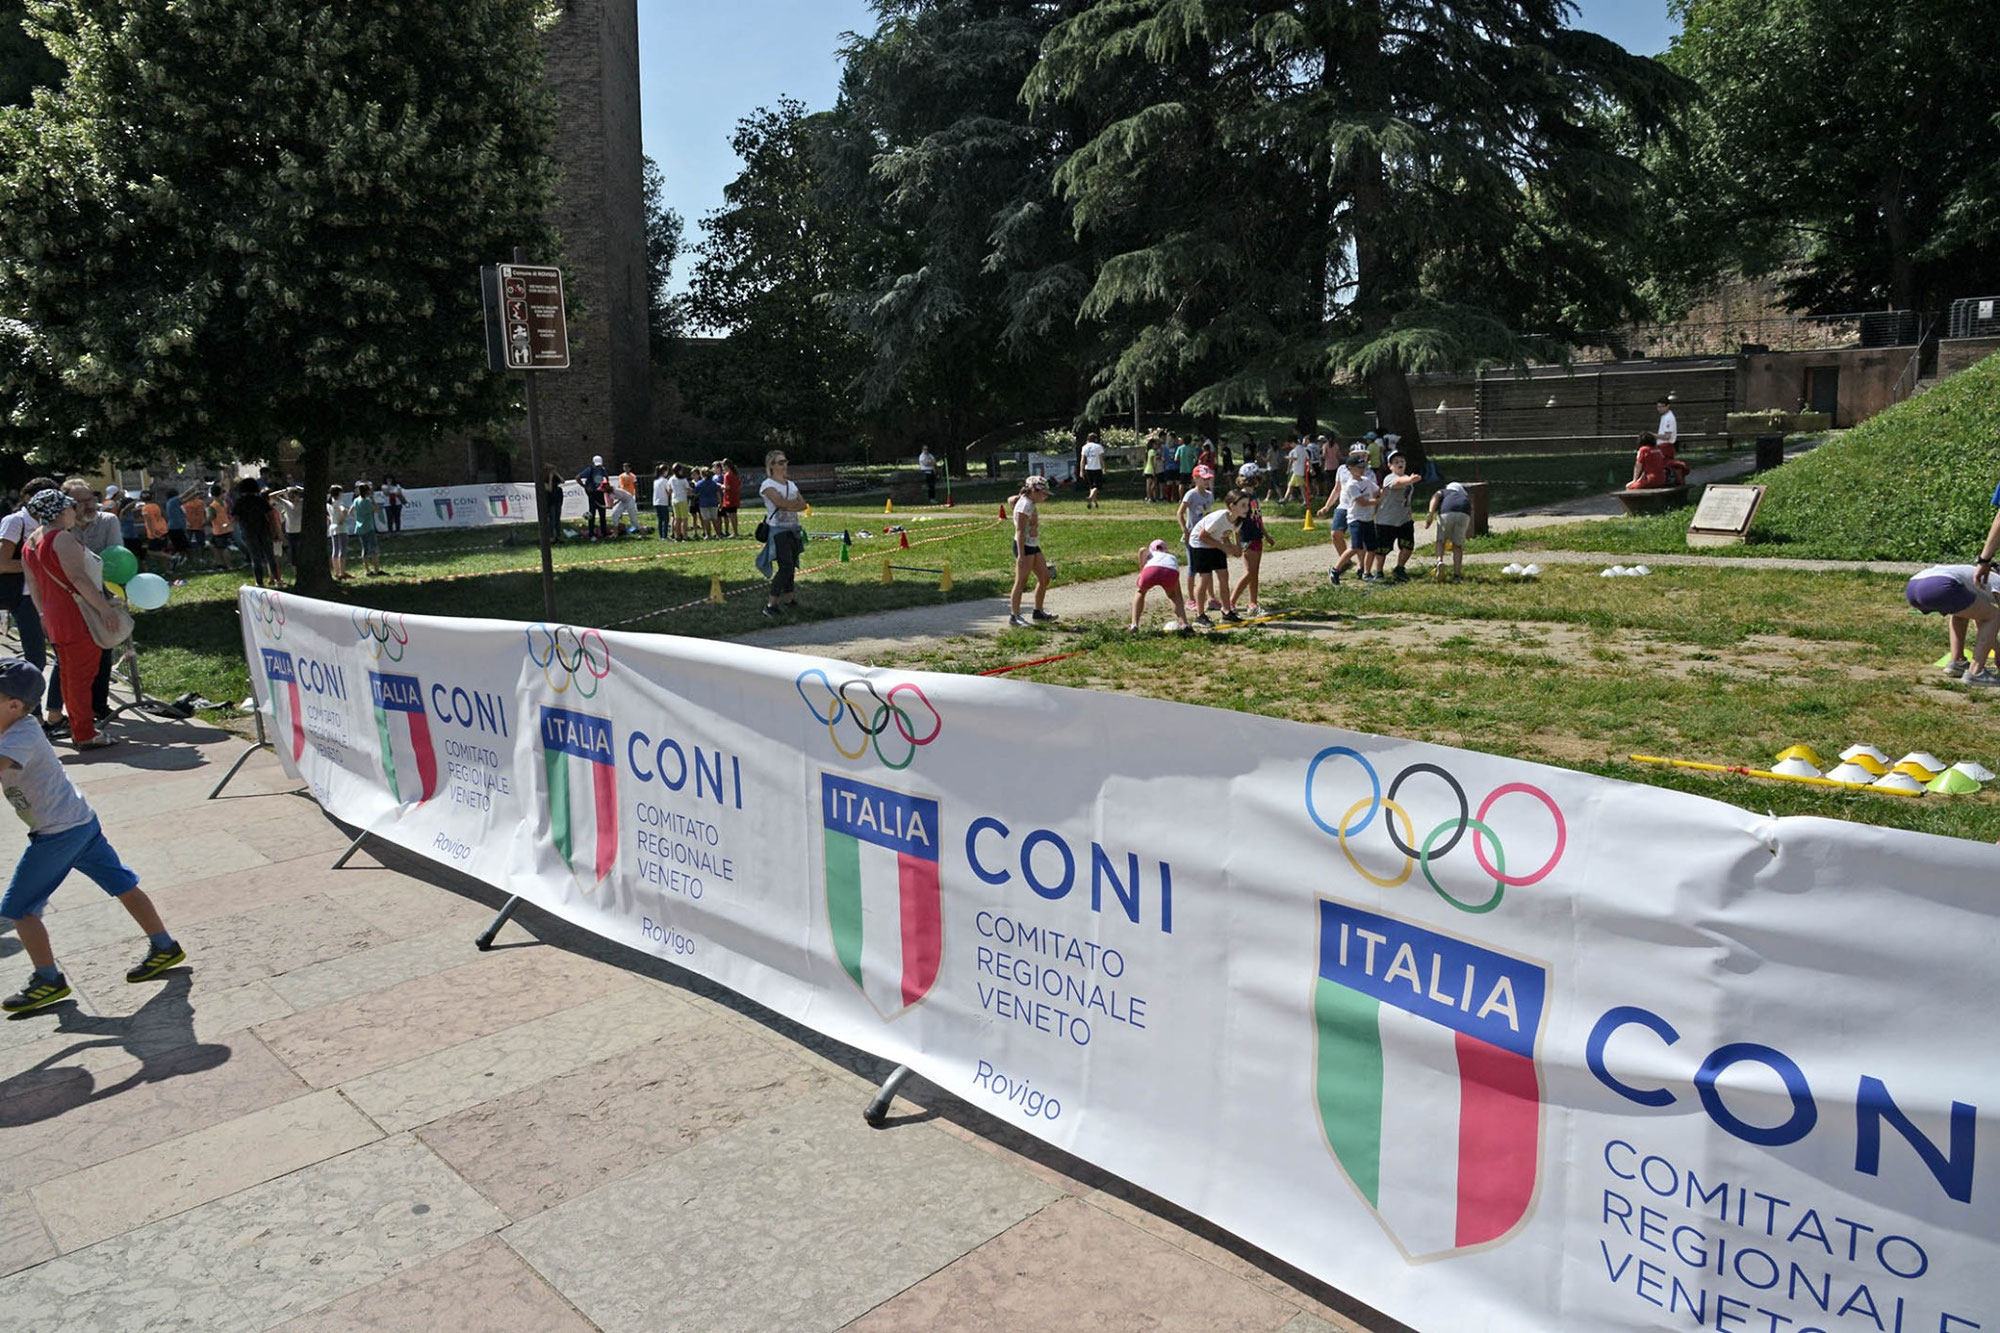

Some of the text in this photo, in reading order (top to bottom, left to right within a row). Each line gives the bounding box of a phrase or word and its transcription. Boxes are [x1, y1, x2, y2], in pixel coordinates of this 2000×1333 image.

[403, 500, 423, 509] ONI
[453, 497, 478, 506] CONI
[508, 494, 532, 502] CONI
[298, 657, 347, 701] CONI
[372, 680, 422, 706] ITALIA
[431, 683, 508, 737] CONI
[444, 739, 499, 769] COMITATO
[546, 716, 611, 756] ITALIA
[447, 761, 510, 796] REGIONALE
[627, 730, 742, 810] CONI
[449, 785, 492, 812] VENETO
[831, 787, 931, 847] ITALIA
[432, 831, 472, 860] Rovigo
[636, 802, 719, 846] COMITATO
[637, 829, 734, 882] REGIONALE
[965, 816, 1173, 934] CONI
[637, 857, 704, 900] VENETO
[641, 916, 696, 955] Rovigo
[975, 911, 1125, 979] COMITATO
[977, 945, 1147, 1030] REGIONALE
[1338, 922, 1521, 1033] ITALIA
[977, 981, 1092, 1047] VENETO
[973, 1059, 1062, 1121] Rovigo
[1604, 1139, 1929, 1279] COMITATO
[1600, 1239, 1832, 1333] VENET
